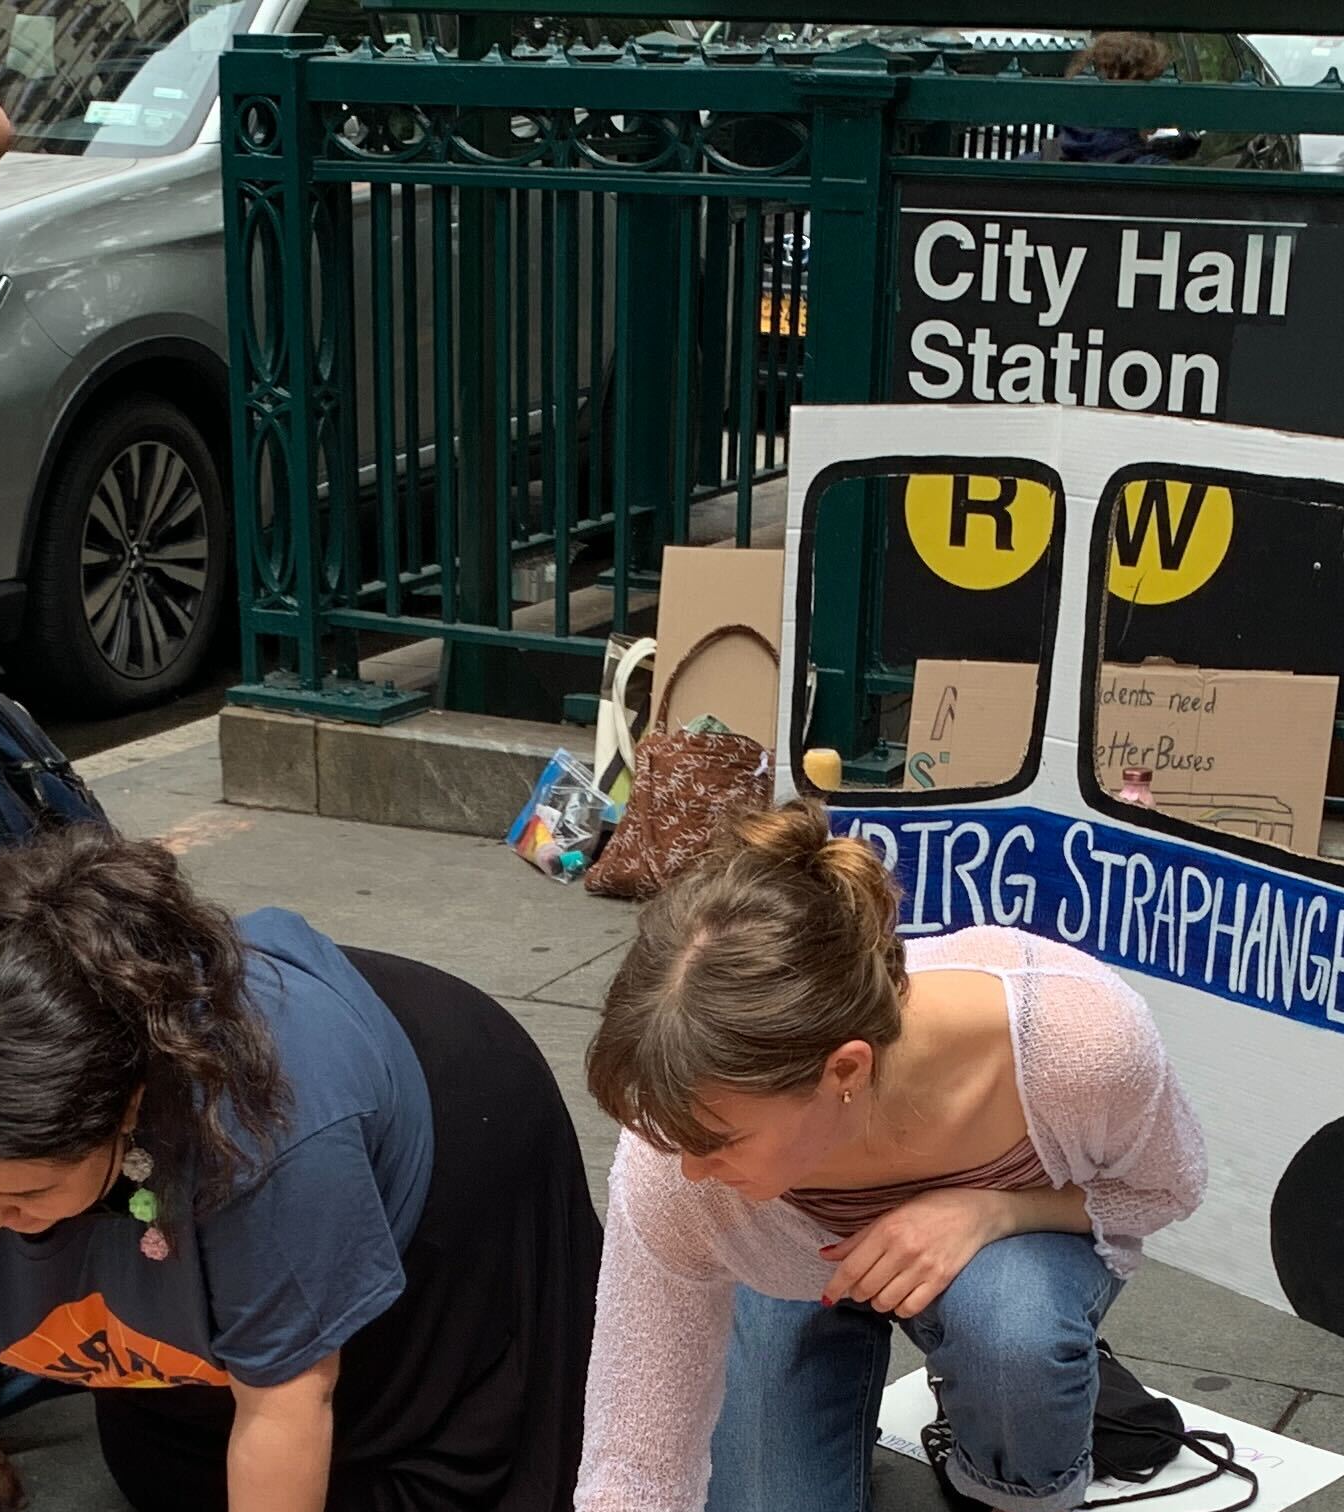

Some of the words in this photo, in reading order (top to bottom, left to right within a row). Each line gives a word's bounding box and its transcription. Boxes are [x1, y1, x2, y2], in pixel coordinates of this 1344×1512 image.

[912, 219, 1088, 326] City
[1116, 229, 1293, 317] Hall
[907, 319, 1221, 415] Station
[948, 475, 1016, 552] R
[1112, 481, 1208, 571] W
[1168, 686, 1217, 714] need
[1155, 735, 1215, 771] Buses
[828, 817, 1037, 934] PIRG
